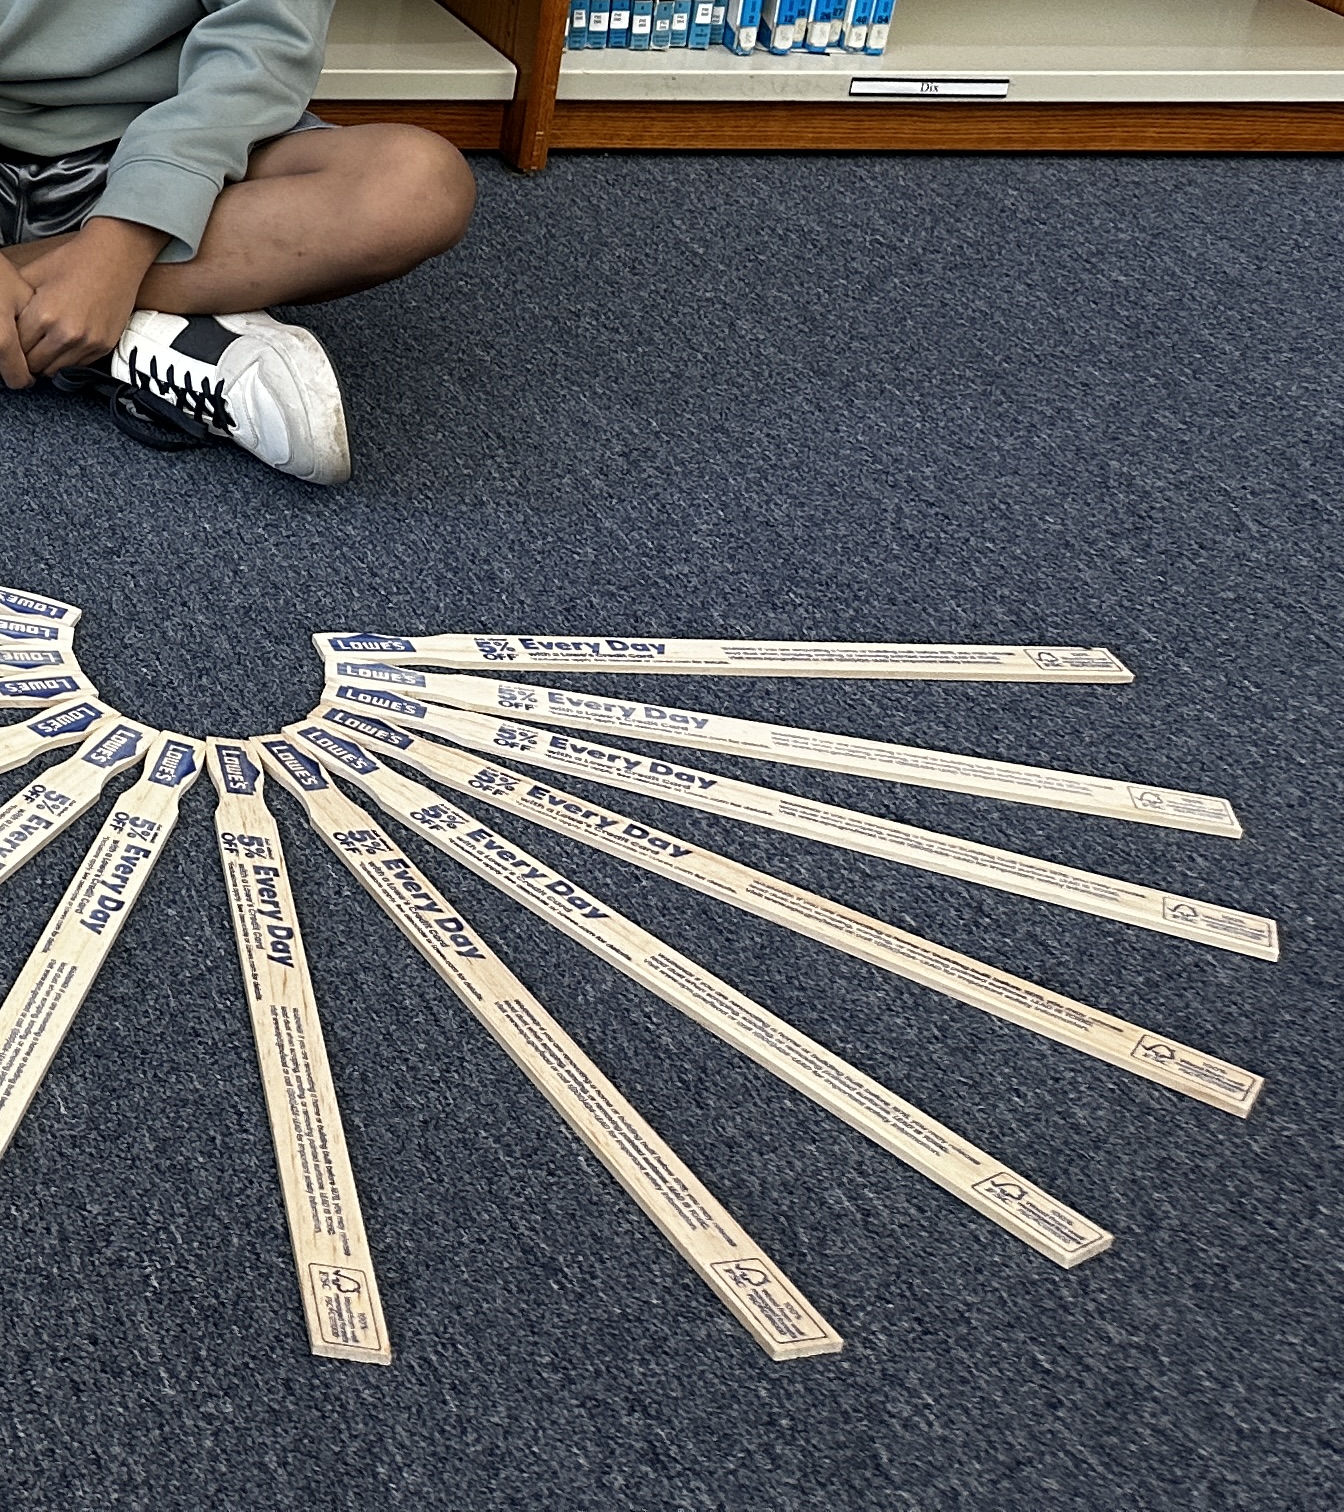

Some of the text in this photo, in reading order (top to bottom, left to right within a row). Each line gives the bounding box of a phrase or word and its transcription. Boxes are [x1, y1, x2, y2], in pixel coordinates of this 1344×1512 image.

[920, 82, 940, 94] Dix
[336, 638, 406, 652] LOWE'S
[476, 639, 515, 654] 5%
[483, 652, 514, 661] OFF
[519, 638, 667, 655] Every Day
[346, 689, 417, 714] LOWE'S
[41, 704, 99, 734] LOWE'S
[332, 710, 404, 746] LOWE'S
[156, 742, 189, 785] LOWE'S
[223, 746, 247, 792] LOWE'S
[548, 736, 719, 790] Every Day
